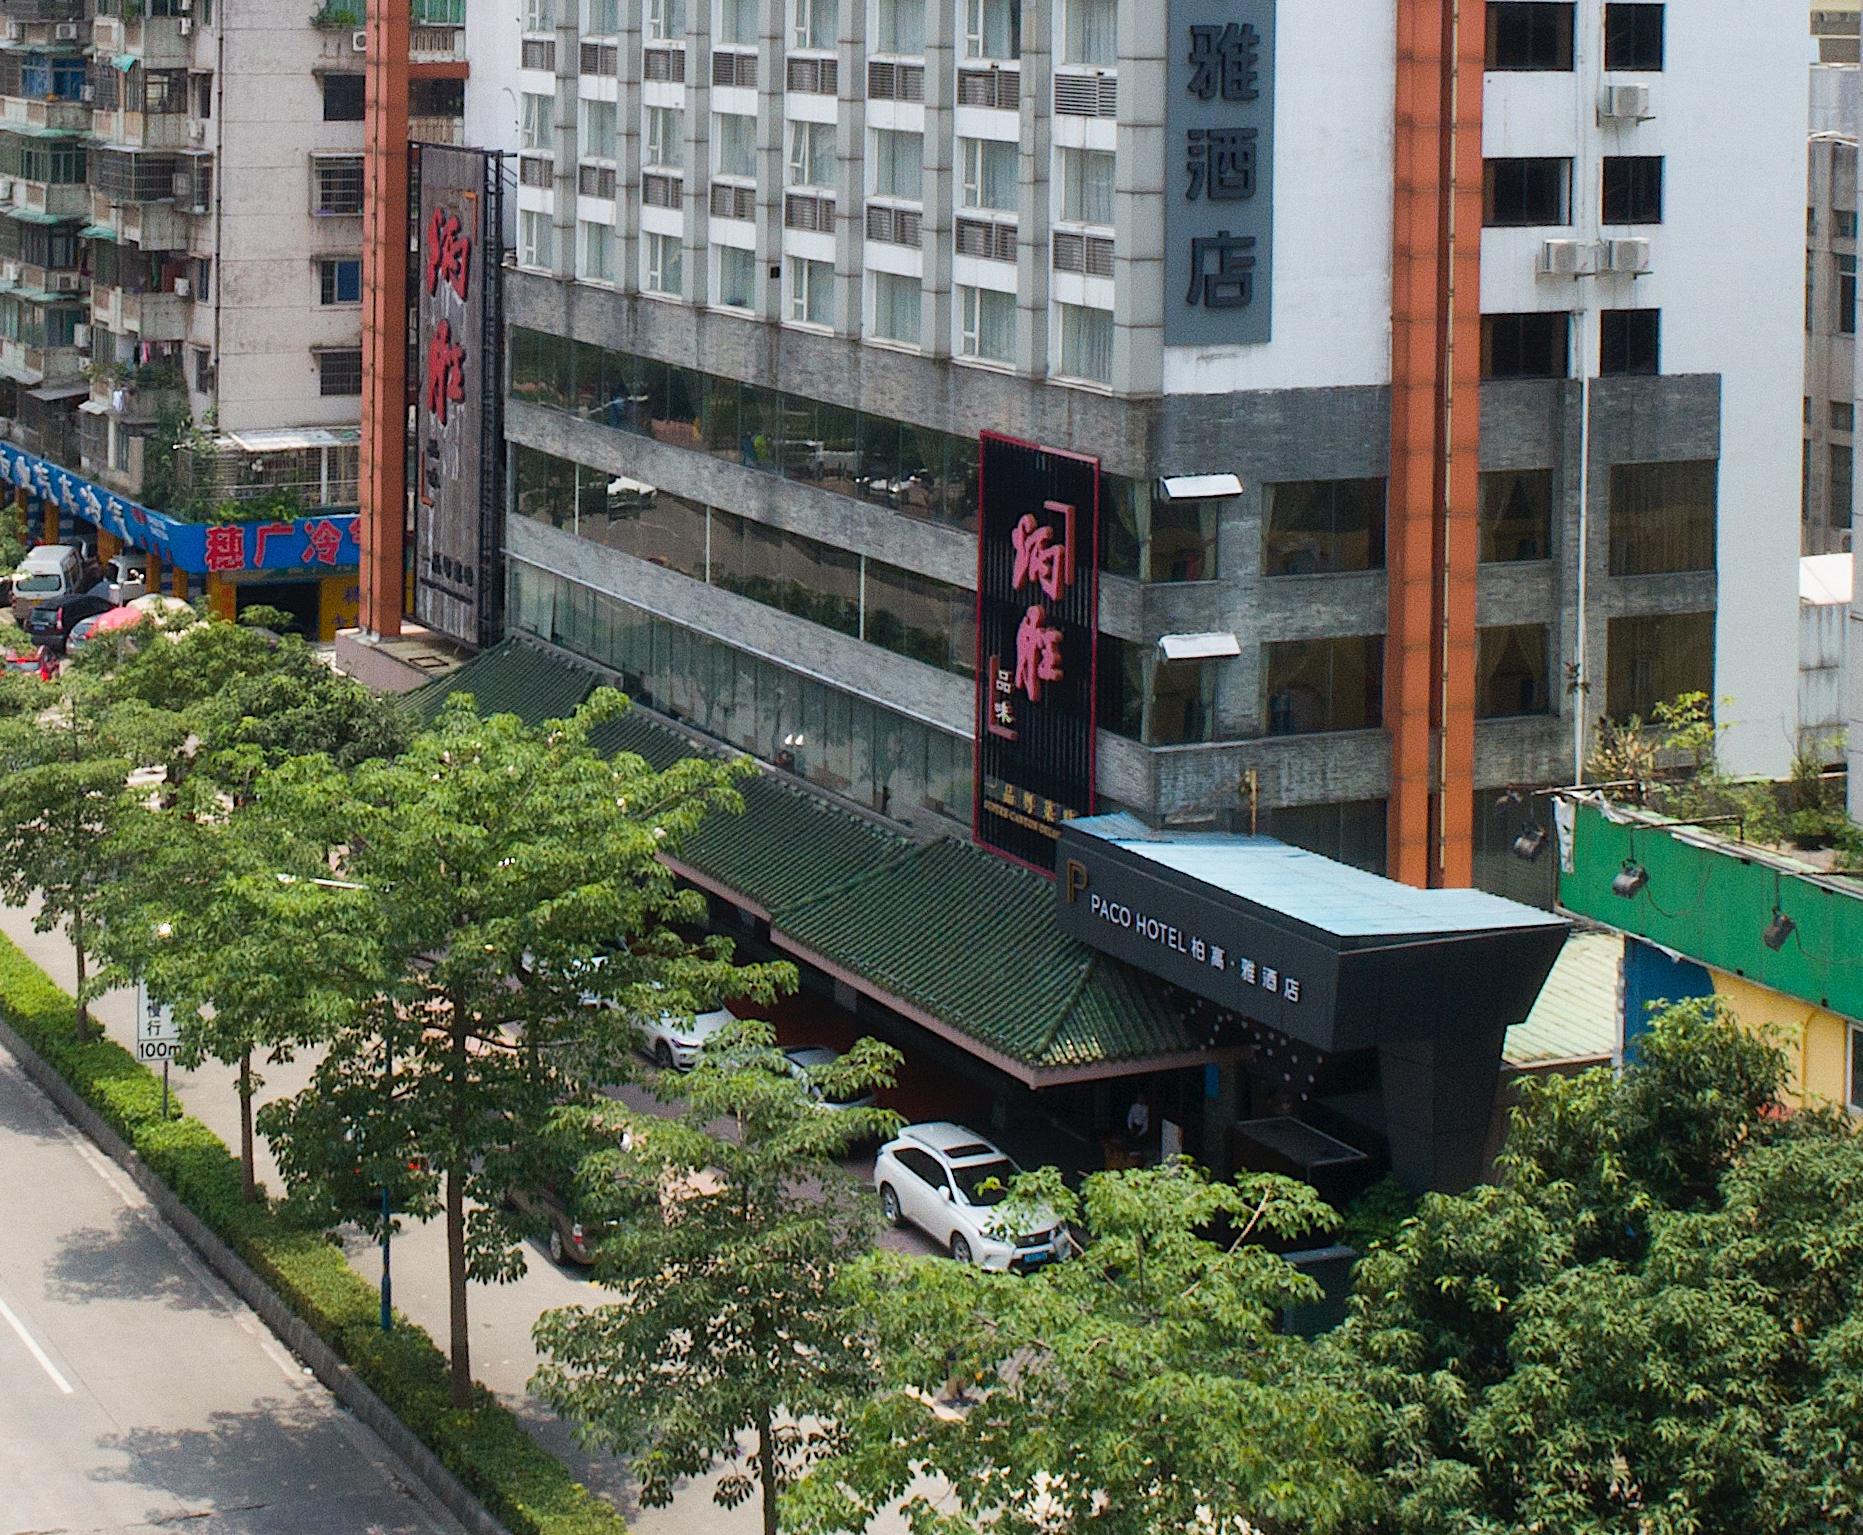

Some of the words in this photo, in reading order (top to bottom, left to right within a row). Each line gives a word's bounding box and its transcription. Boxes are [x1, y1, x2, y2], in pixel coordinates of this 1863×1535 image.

[1090, 893, 1132, 928] PACO
[1135, 913, 1188, 954] HOTEL
[140, 1042, 182, 1059] 100m
